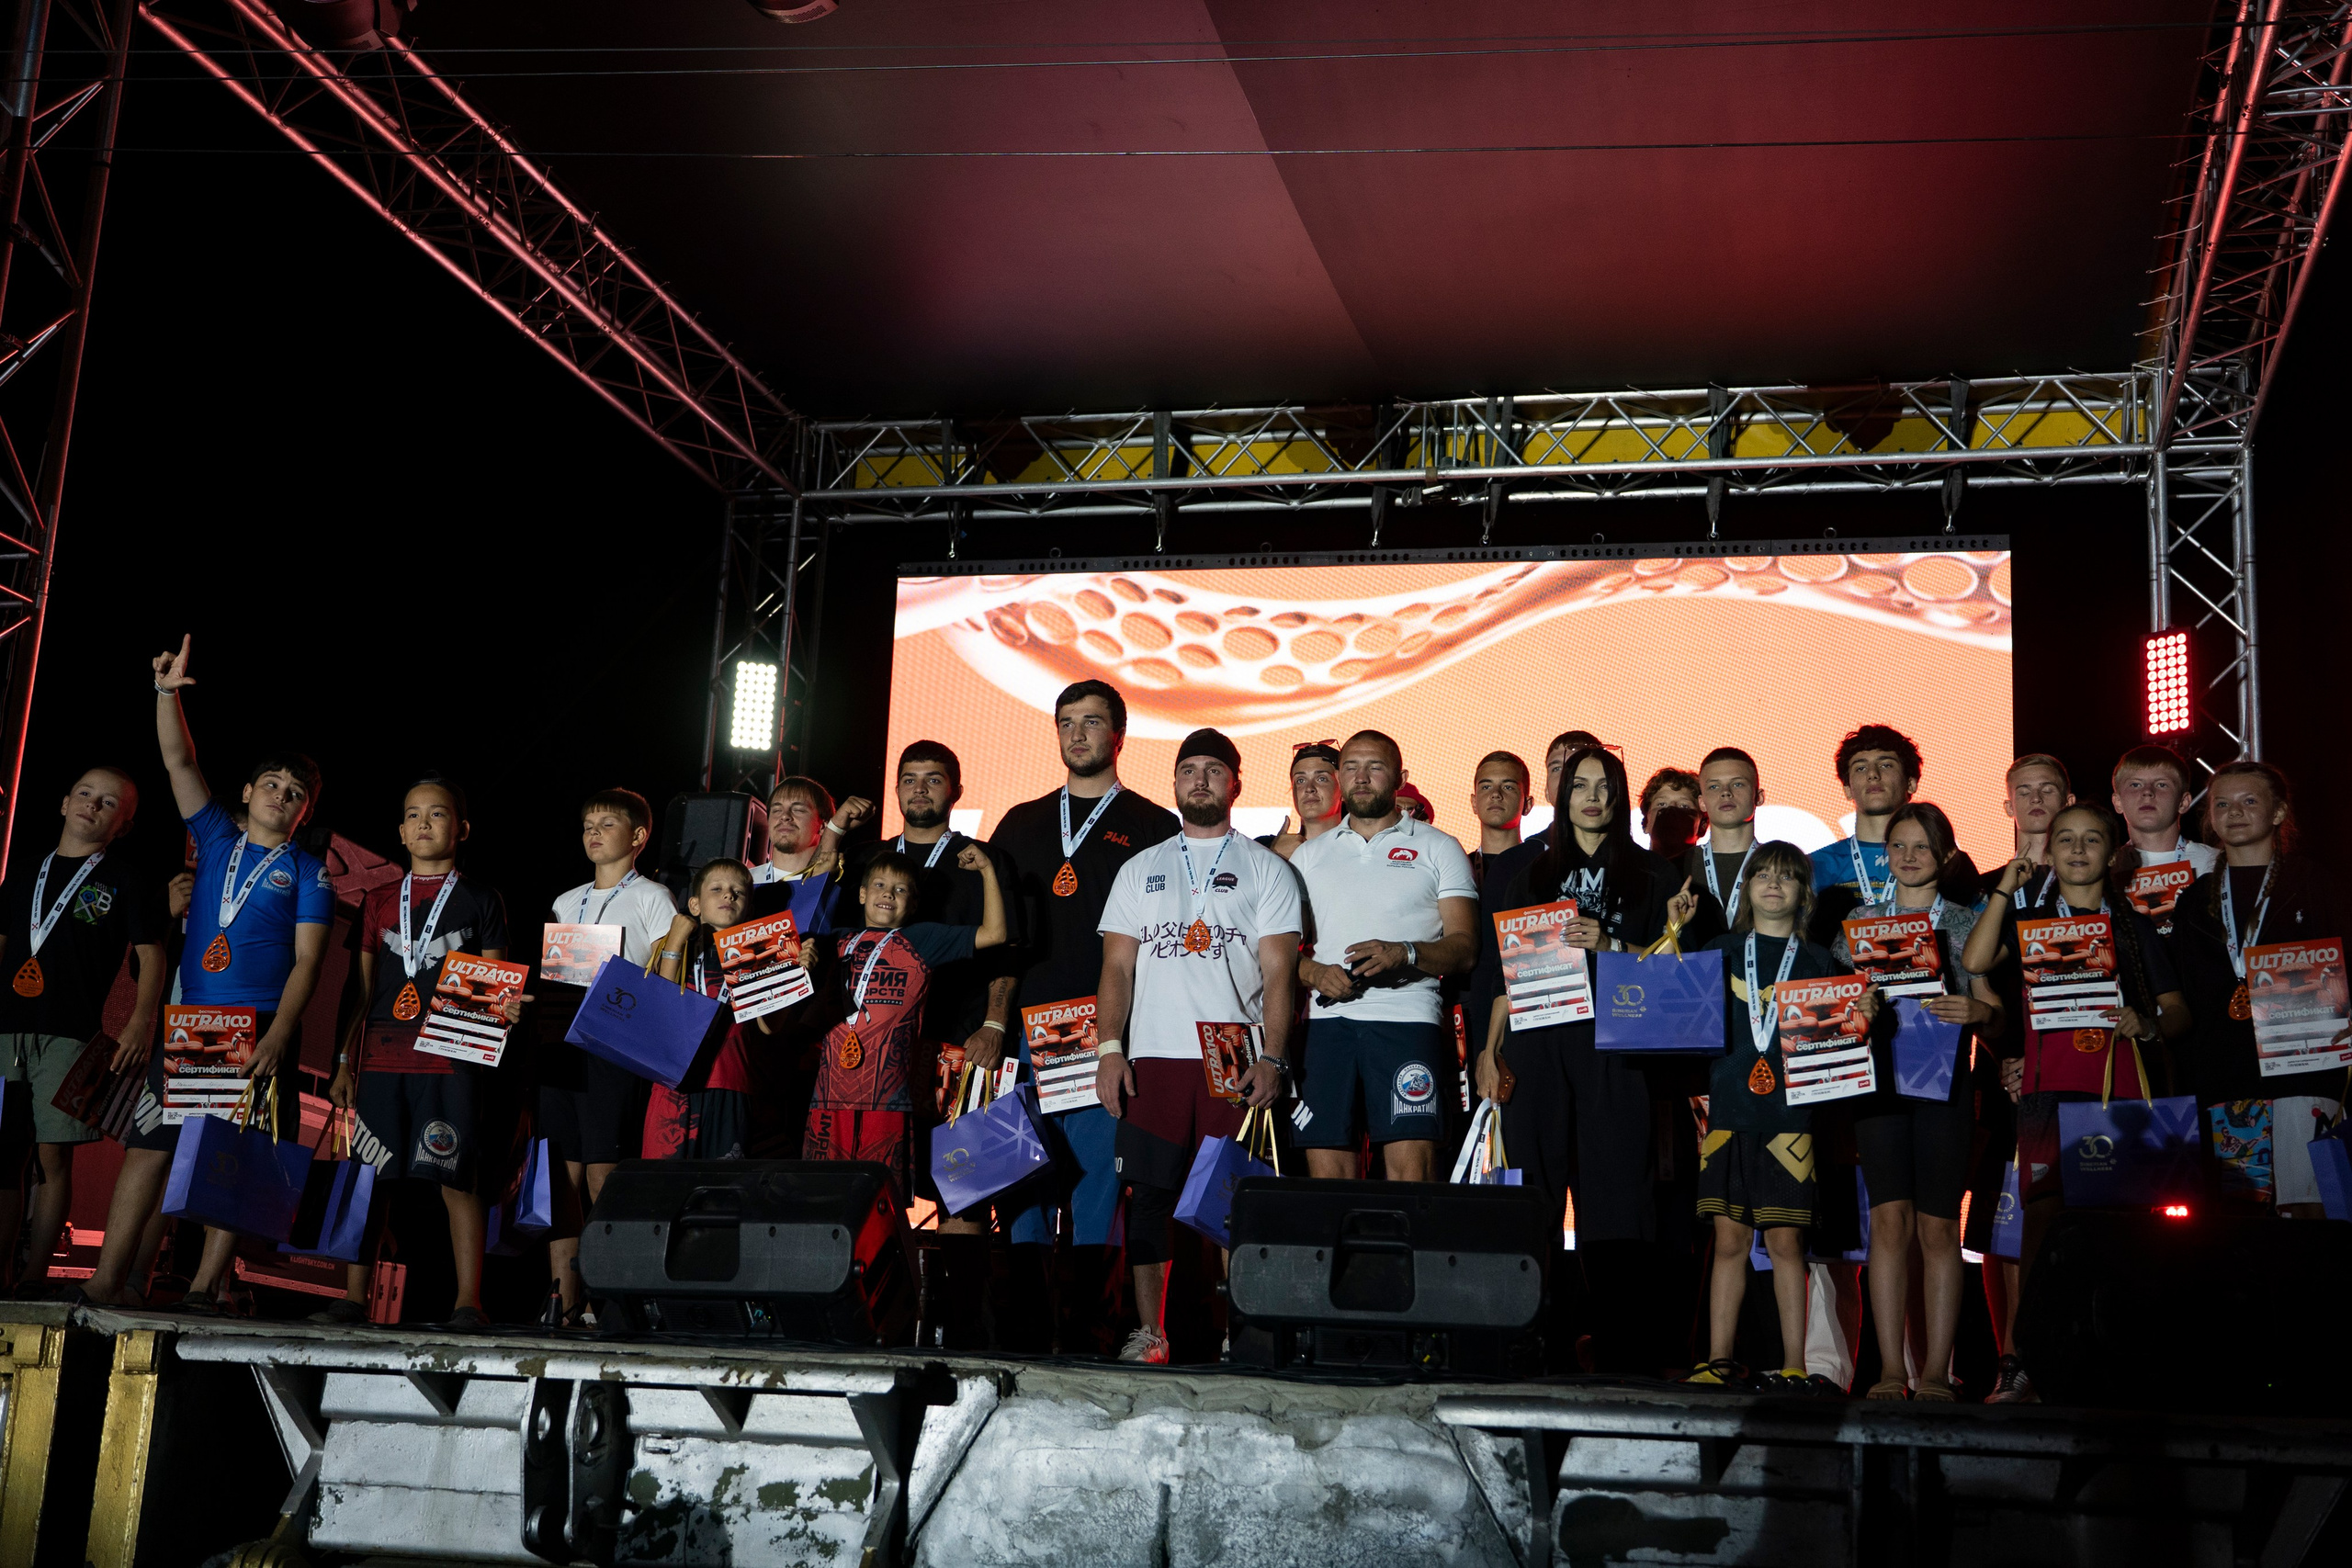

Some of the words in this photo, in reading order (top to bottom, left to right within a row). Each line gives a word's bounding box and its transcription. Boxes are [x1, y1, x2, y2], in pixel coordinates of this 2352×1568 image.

[1102, 830, 1131, 847] PWL
[1146, 883, 1166, 894] CLUB
[1147, 874, 1166, 885] JUDO
[1499, 908, 1575, 933] ULTRA100
[1849, 920, 1928, 940] ULTRA100
[719, 919, 791, 948] ULTRA100
[2022, 922, 2107, 942] ULTRA100
[2251, 947, 2338, 970] ULTRA100
[447, 959, 523, 985] ULTRA100
[739, 961, 793, 982] сертификат
[1517, 962, 1574, 978] сертификат
[1871, 970, 1929, 983] сертификат
[2040, 971, 2104, 983] сертификат
[1612, 984, 1645, 1007] 30
[1781, 982, 1863, 1004] ULTRA100
[169, 1013, 252, 1028] ULTRA100
[443, 1006, 500, 1023] сертификат
[1027, 1004, 1096, 1026] ULTRA100
[2268, 1006, 2335, 1020] сертификат
[1795, 1036, 1857, 1052] сертификат
[1045, 1050, 1096, 1066] сертификат
[1203, 1024, 1225, 1094] ULTRA100
[179, 1066, 241, 1074] сертификат
[1394, 1093, 1437, 1115] ПАНКРАТИОН
[2078, 1134, 2114, 1158] 30
